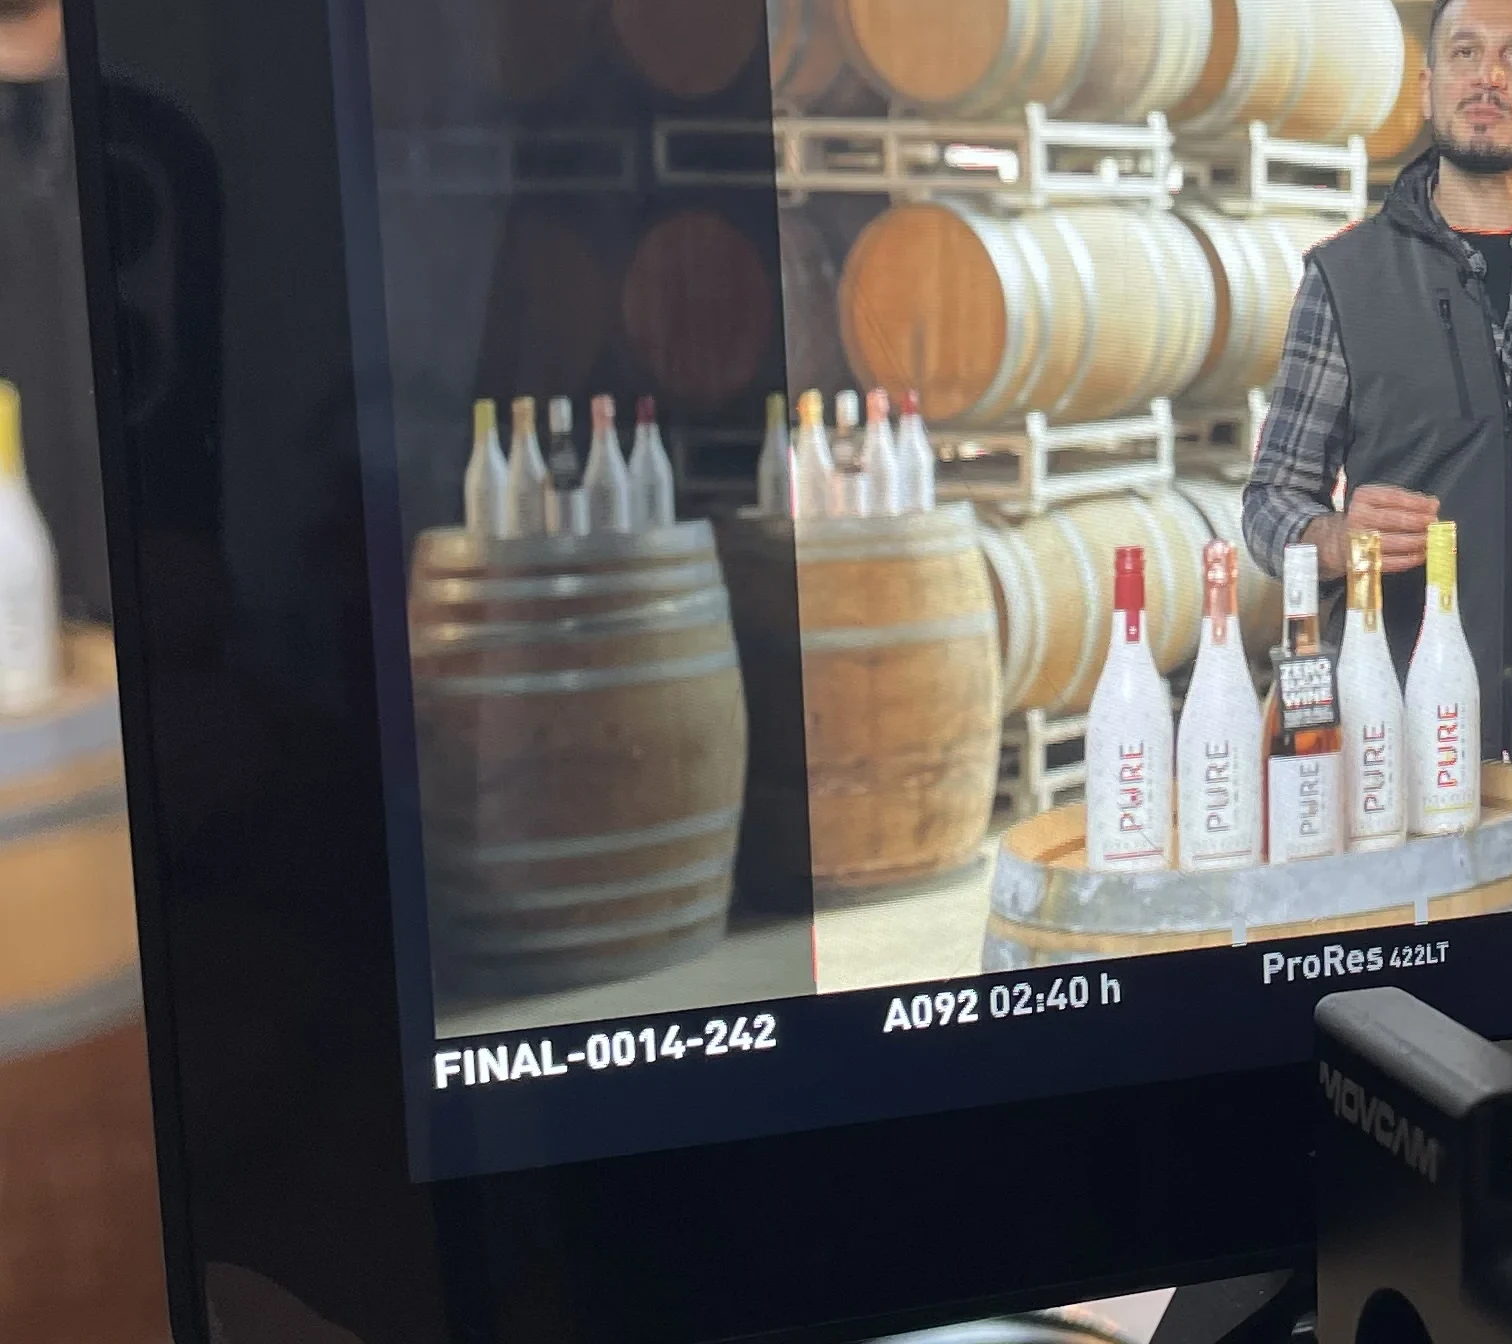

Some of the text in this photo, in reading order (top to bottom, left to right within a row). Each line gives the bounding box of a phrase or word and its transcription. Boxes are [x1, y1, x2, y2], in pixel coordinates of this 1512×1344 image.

[1118, 740, 1145, 833] PURE
[1206, 740, 1231, 833] PURE
[1362, 720, 1386, 815] PURE
[1436, 702, 1459, 789] PURE
[1299, 763, 1321, 836] PURE
[882, 972, 1122, 1033] A092 02:40 h
[1263, 941, 1450, 984] ProRes 422LT
[434, 1013, 777, 1089] FINAL-0014-242
[1318, 1059, 1440, 1184] MOVCAM
